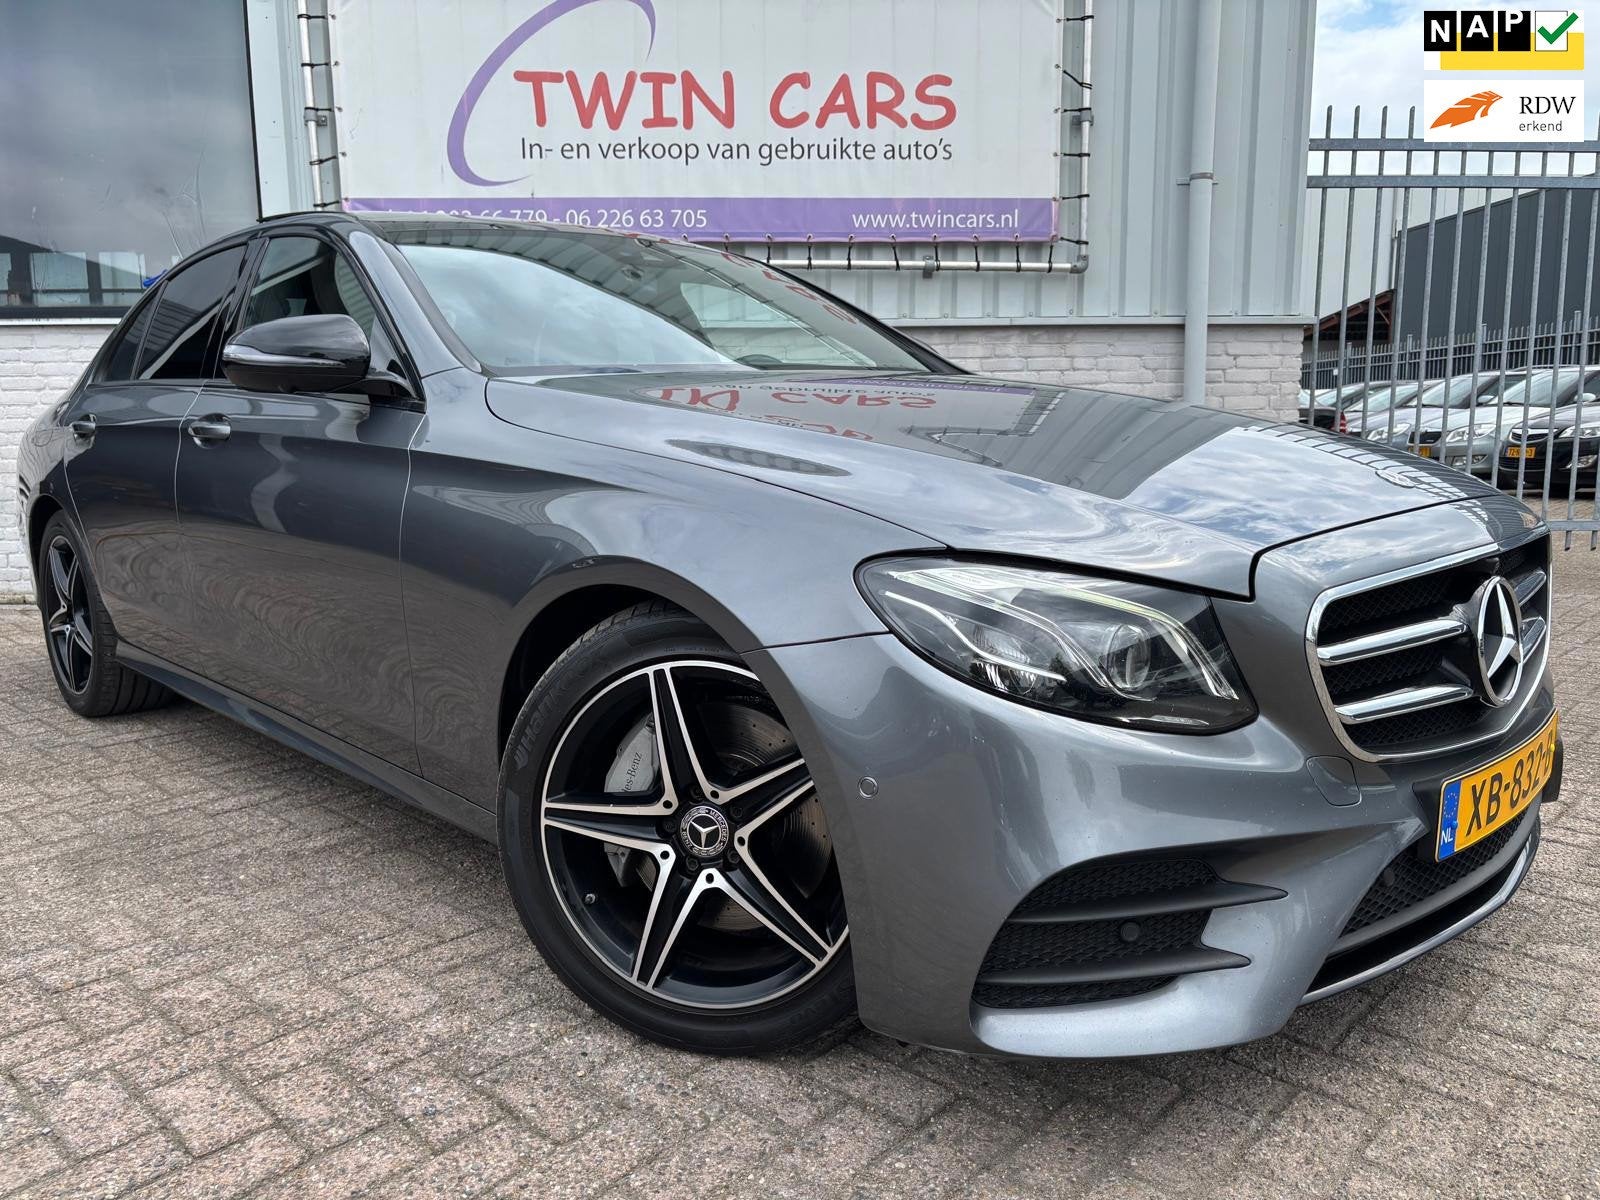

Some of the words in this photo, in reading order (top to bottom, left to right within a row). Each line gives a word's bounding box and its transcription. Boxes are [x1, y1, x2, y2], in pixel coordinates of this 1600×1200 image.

[513, 70, 735, 131] TWIN
[769, 71, 957, 131] CARS
[521, 137, 553, 160] In-
[560, 142, 590, 159] en
[598, 136, 700, 166] verkoop
[707, 142, 750, 160] van
[758, 137, 876, 166] gebruikte
[883, 137, 953, 160] auto's
[566, 209, 591, 226] 06
[597, 209, 634, 228] 226
[640, 209, 664, 228] 63
[671, 209, 707, 228] 705
[852, 208, 1019, 228] www.twincars.nl
[708, 810, 727, 842] MERCEDES
[1440, 827, 1453, 846] NL
